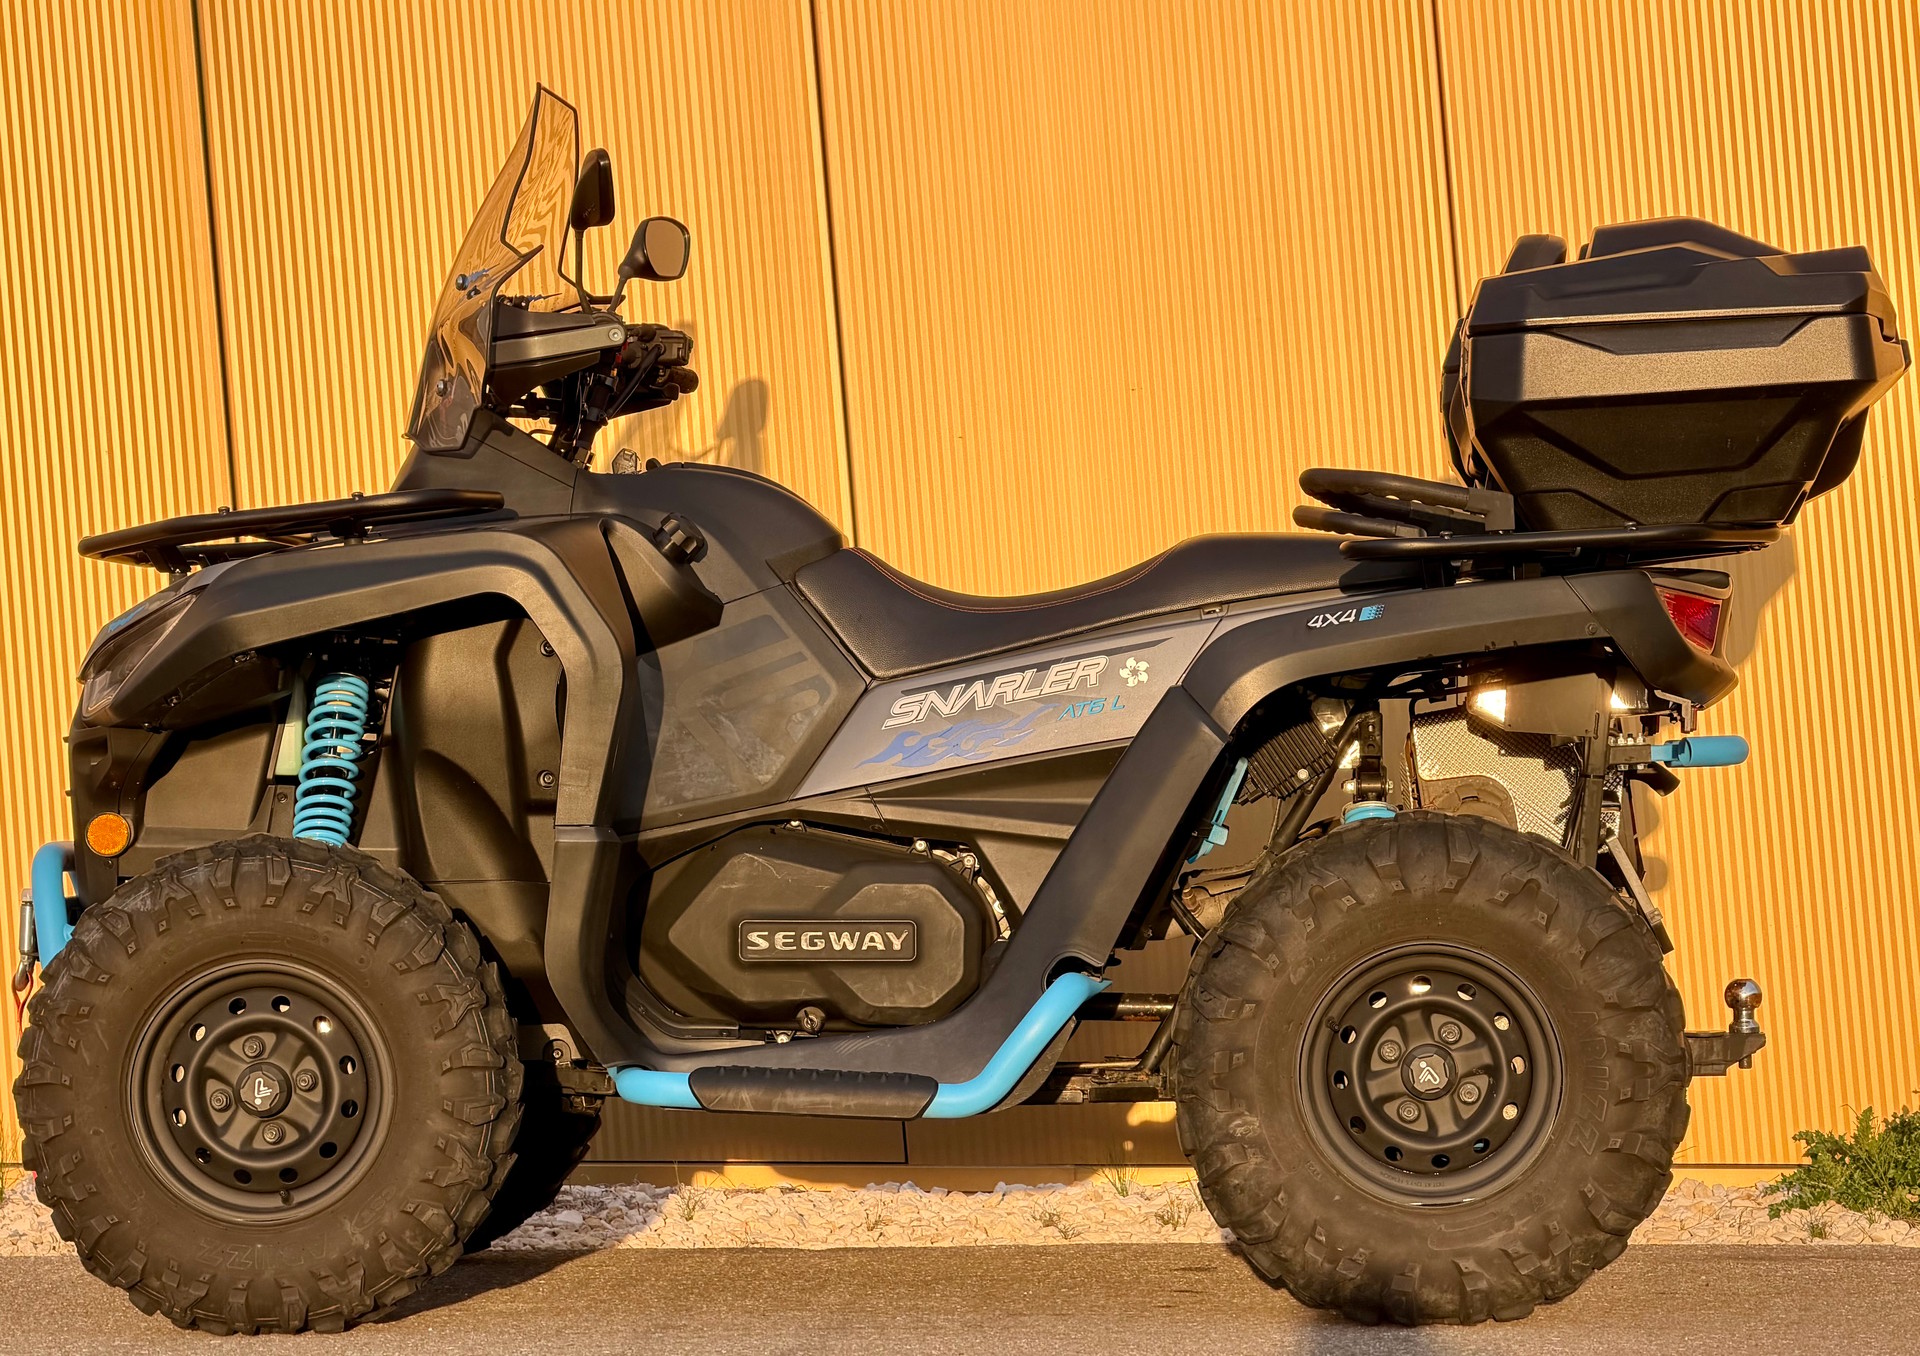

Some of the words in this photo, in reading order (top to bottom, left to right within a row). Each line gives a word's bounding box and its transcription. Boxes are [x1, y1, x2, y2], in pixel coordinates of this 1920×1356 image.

[1307, 608, 1357, 628] 4X4
[881, 655, 1110, 730] SNARLER
[1058, 698, 1105, 721] AT6
[1111, 694, 1125, 711] L
[745, 929, 909, 951] SEGWAY
